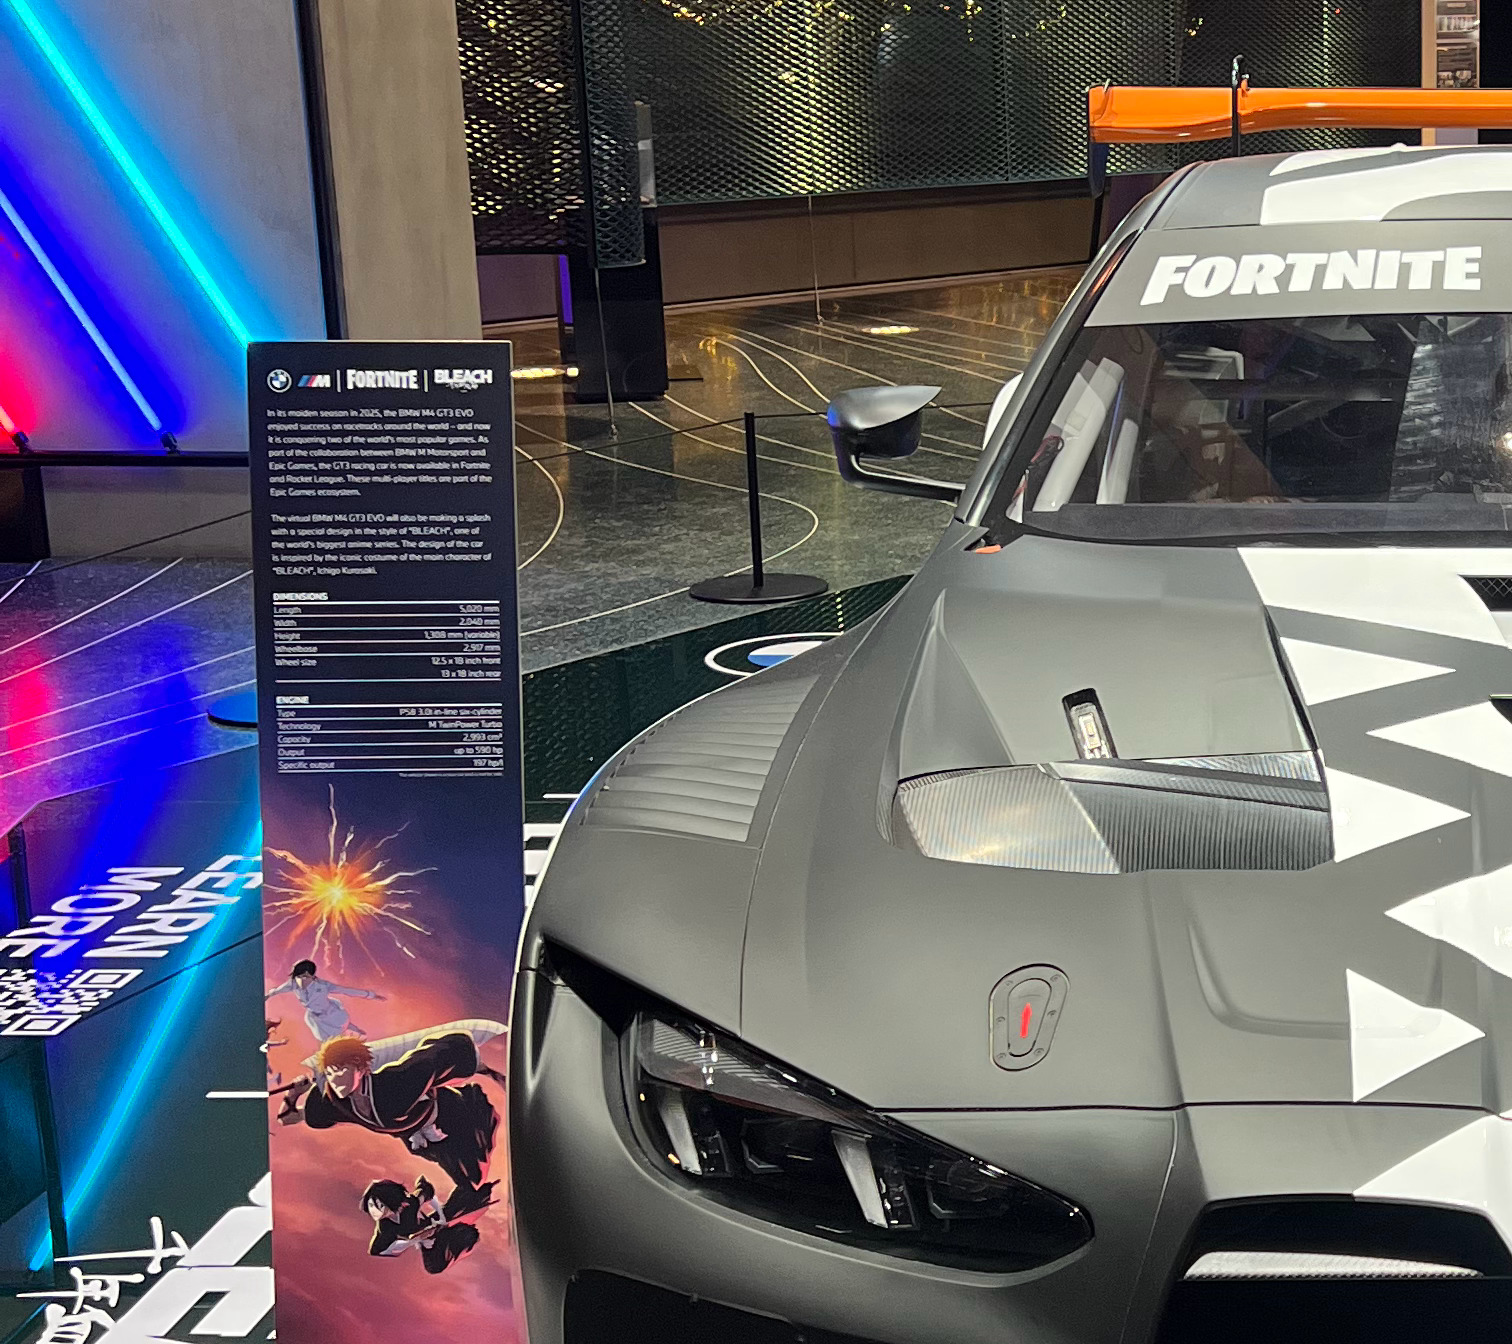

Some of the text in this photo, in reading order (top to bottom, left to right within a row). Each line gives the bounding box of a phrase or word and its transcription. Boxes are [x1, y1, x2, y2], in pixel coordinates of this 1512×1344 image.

[1140, 246, 1482, 306] FORTNITE
[347, 369, 419, 390] FORTNITE
[434, 369, 493, 384] BLEACH
[436, 409, 453, 418] GT3
[455, 409, 474, 418] EVO
[333, 461, 350, 470] GT3
[349, 514, 365, 522] GT3
[367, 514, 384, 522] EVO
[0, 867, 185, 958] MORE
[82, 854, 264, 958] LEARN
